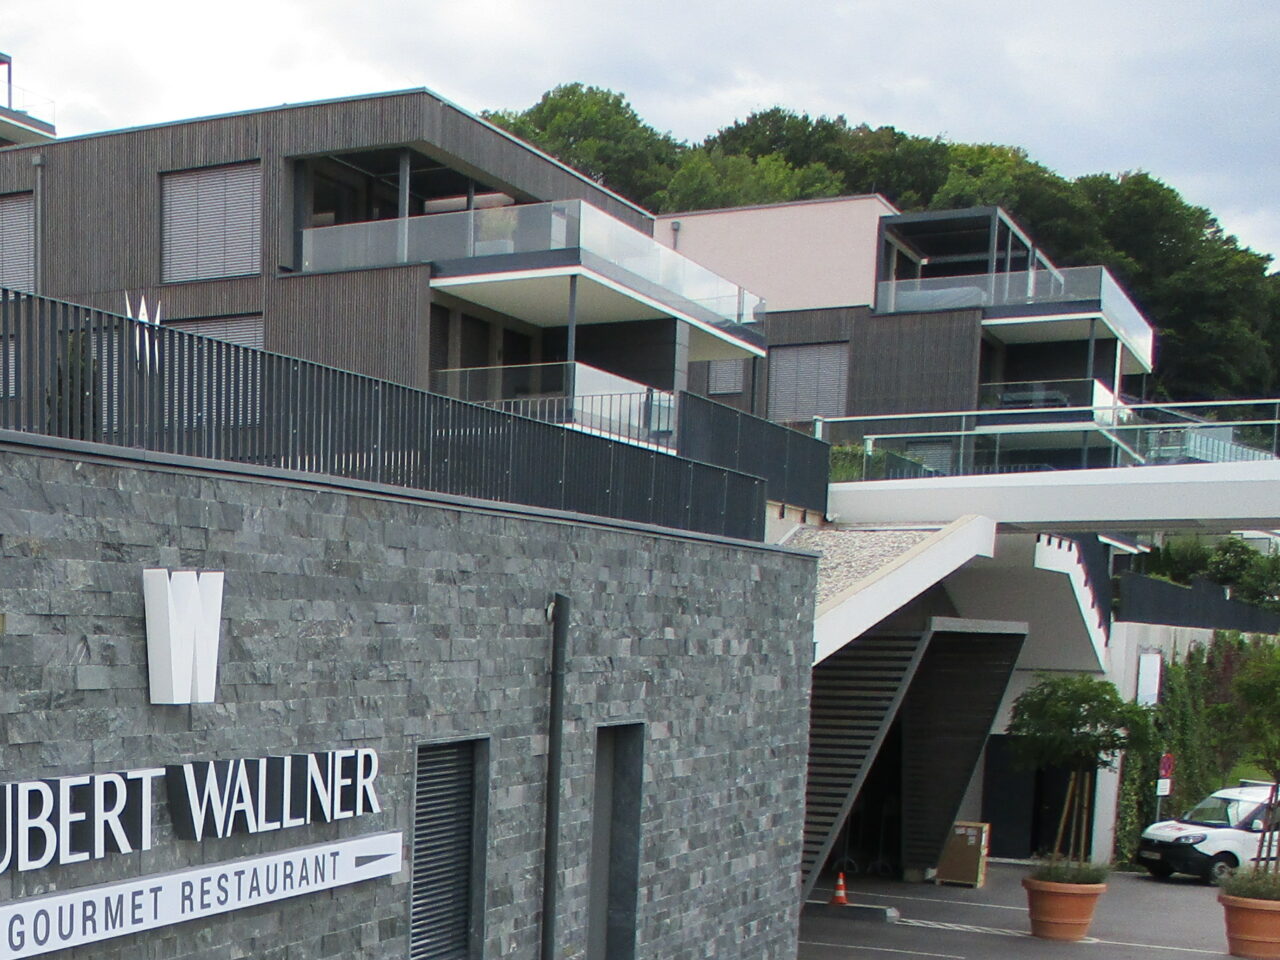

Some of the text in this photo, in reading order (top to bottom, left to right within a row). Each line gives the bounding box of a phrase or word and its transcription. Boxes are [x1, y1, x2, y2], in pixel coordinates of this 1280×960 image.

[183, 747, 382, 842] WALLNER
[7, 851, 340, 952] GOURMET RESTAURANT
